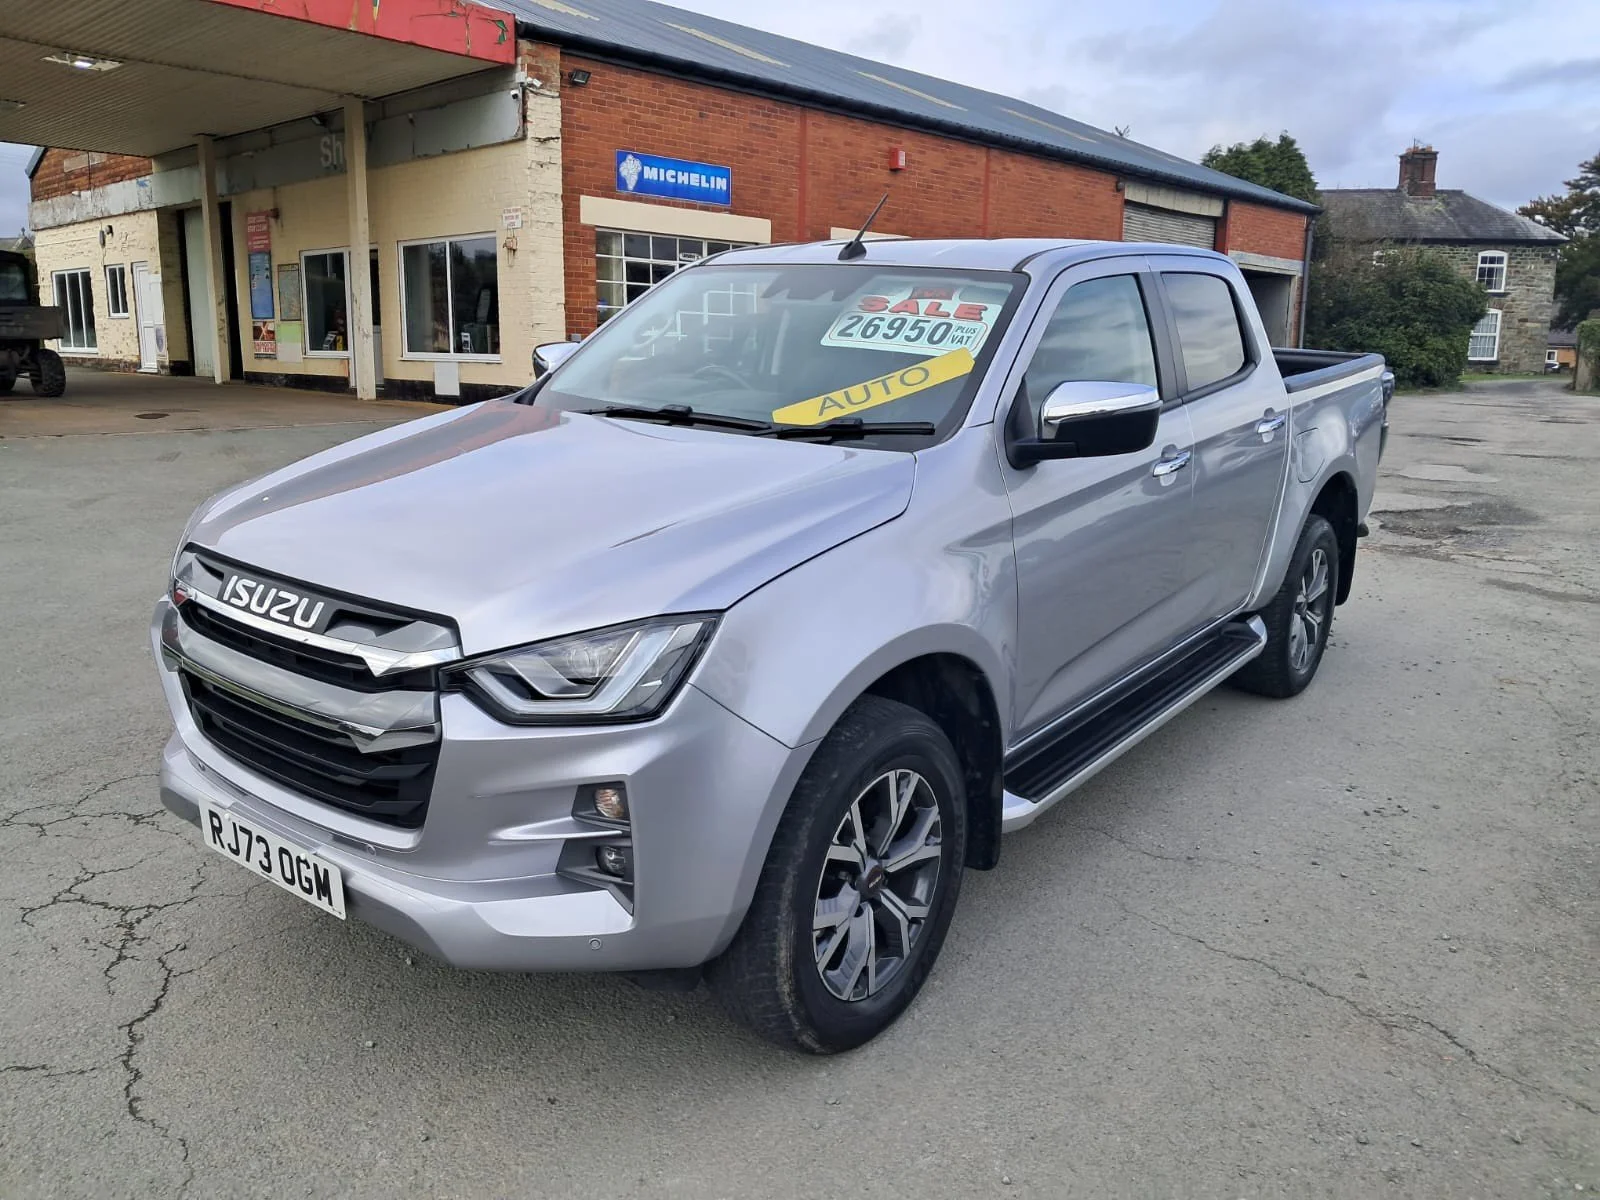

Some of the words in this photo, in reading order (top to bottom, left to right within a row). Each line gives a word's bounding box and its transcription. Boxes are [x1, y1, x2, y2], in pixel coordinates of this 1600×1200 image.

[320, 134, 346, 168] Sh
[643, 165, 727, 191] MICHELIN
[857, 295, 989, 322] SALE
[836, 315, 954, 346] 26950
[950, 334, 973, 346] VAT
[955, 325, 979, 335] PLUS
[817, 366, 930, 417] AUTO
[222, 575, 325, 629] ISUZU
[207, 808, 273, 874] RJ73
[277, 845, 334, 907] OGM
